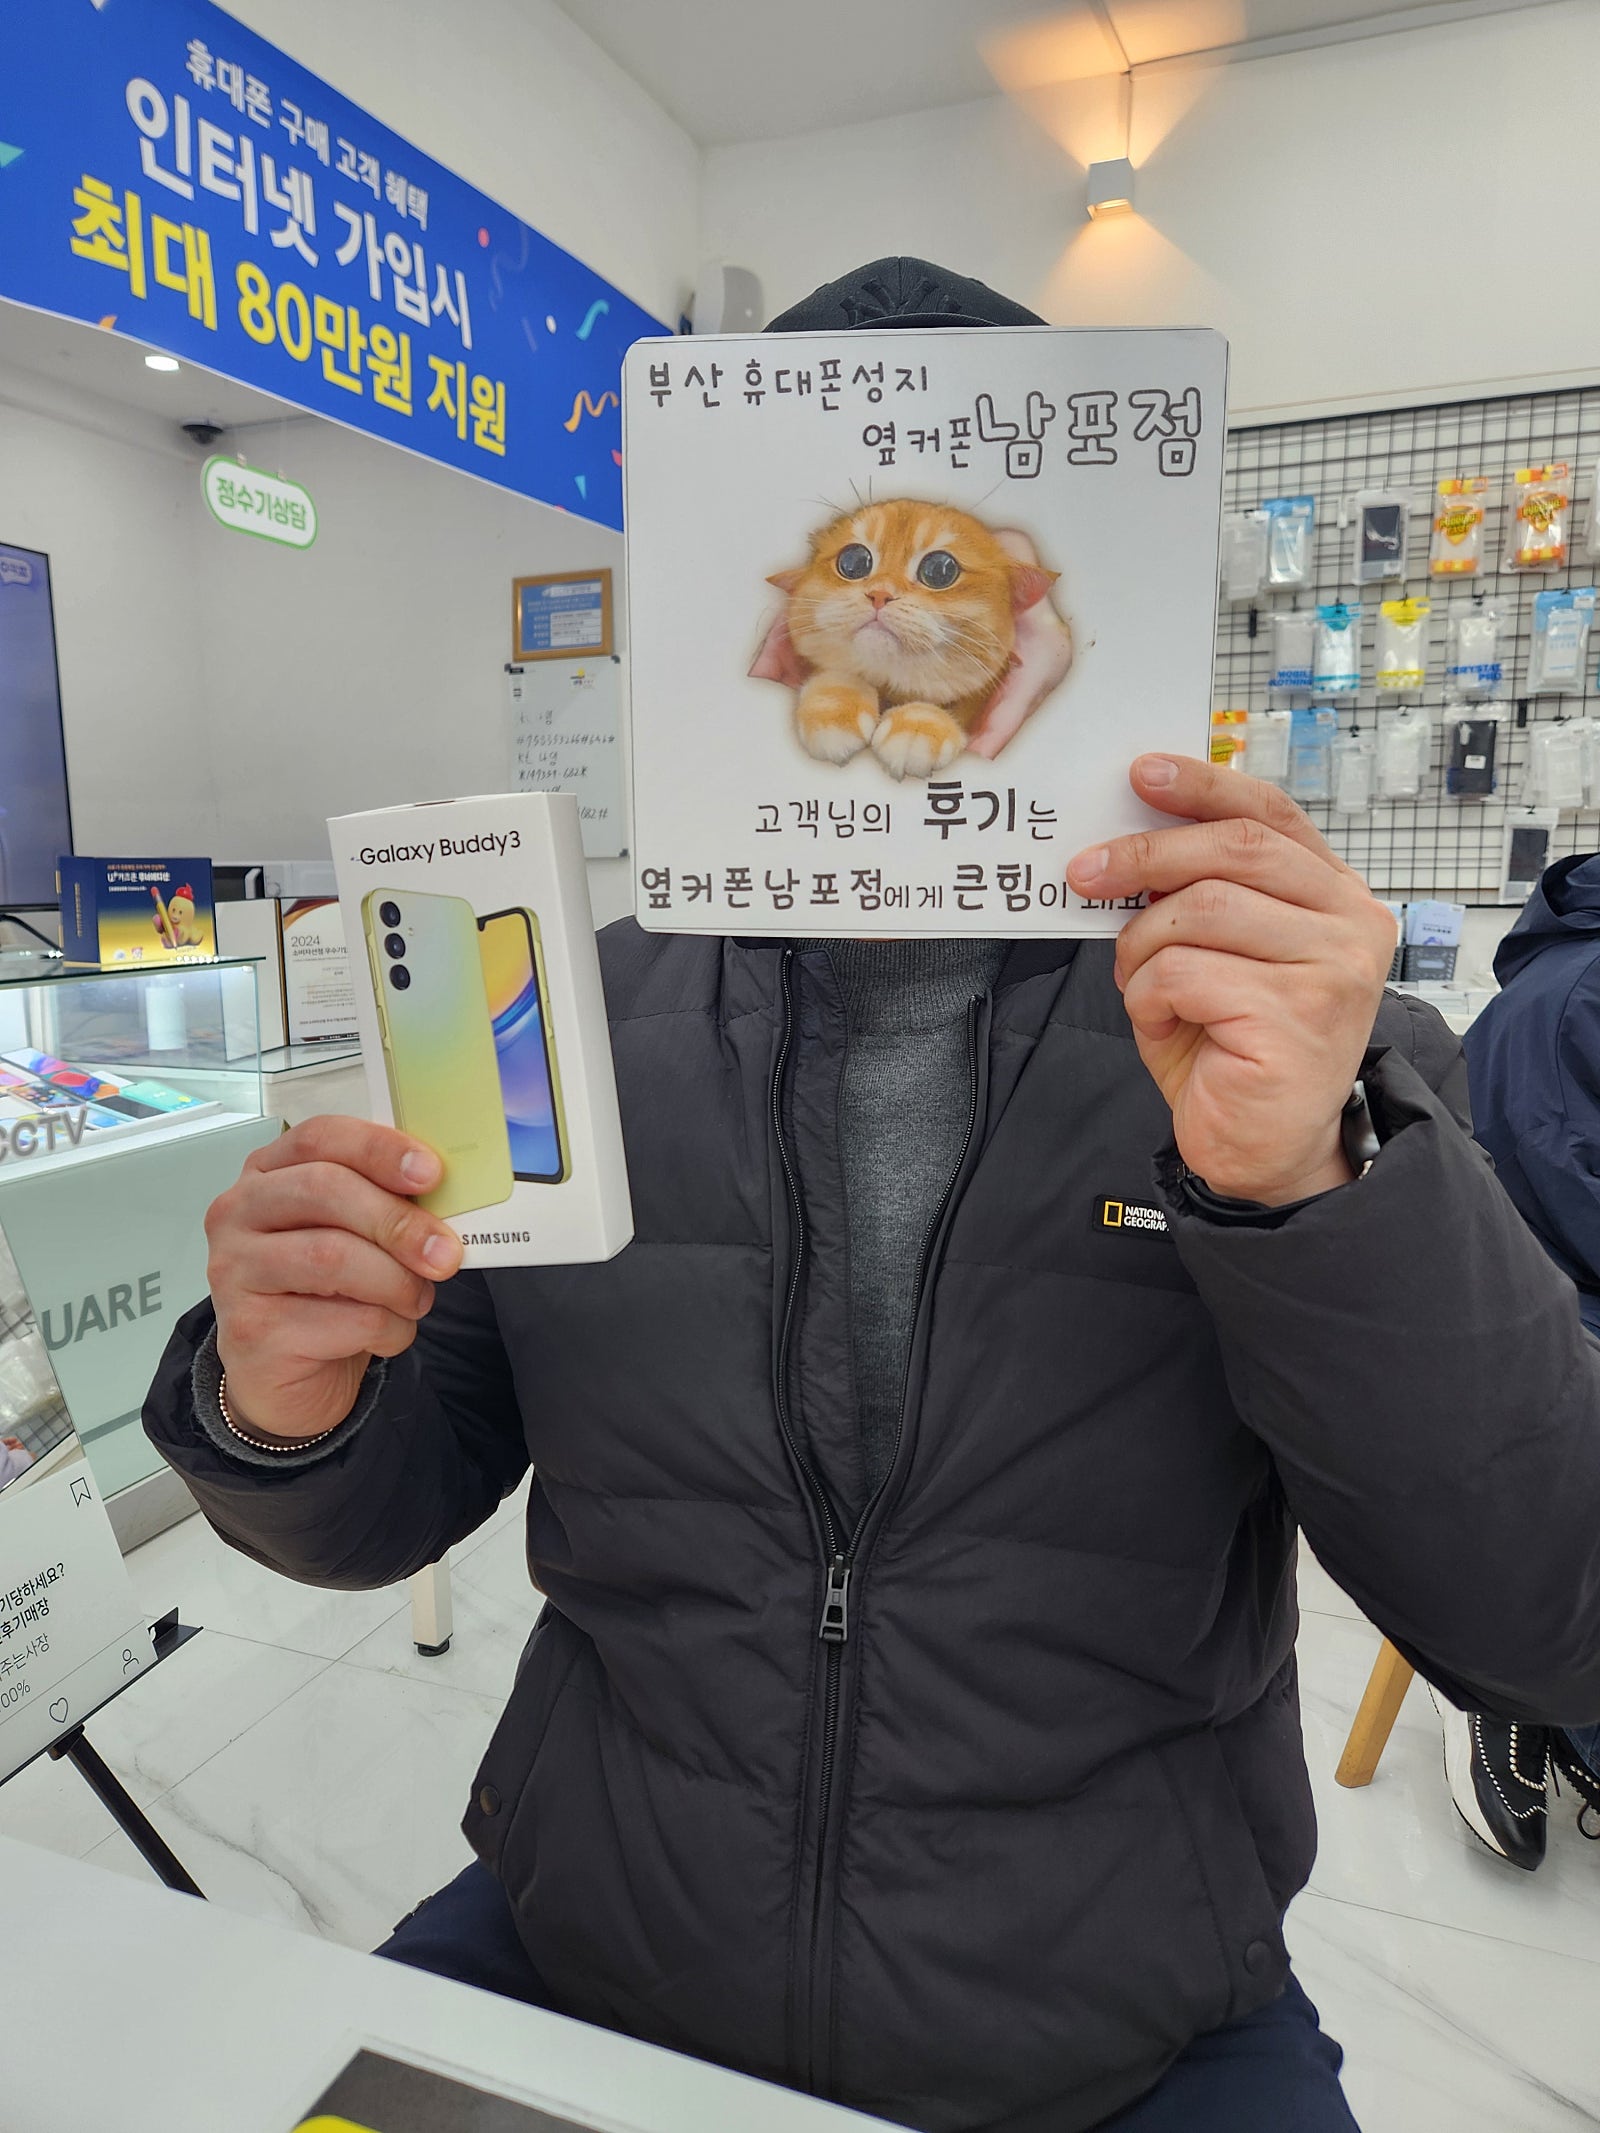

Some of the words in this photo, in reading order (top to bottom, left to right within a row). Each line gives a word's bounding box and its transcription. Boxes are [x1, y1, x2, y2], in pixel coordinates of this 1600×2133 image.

[185, 38, 273, 129] 휴대폰
[279, 98, 331, 168] 구매
[335, 136, 381, 201] 고객
[384, 169, 429, 232] 혜택
[125, 77, 318, 268] 인터넷
[333, 200, 472, 349] 가입시
[70, 173, 218, 330] 최대
[234, 260, 413, 416] 80만원
[427, 355, 506, 456] 지원
[650, 361, 723, 408] 부산
[745, 358, 928, 411] 휴대폰성지
[216, 477, 306, 531] 정수기상담
[755, 799, 891, 840] 고객님의
[924, 780, 1058, 840] 후기는
[360, 843, 434, 865] Galaxy
[439, 830, 521, 857] Buddy3
[291, 935, 320, 947] 2024
[0, 1103, 87, 1161] CTV
[462, 1231, 530, 1246] SAMSUNG
[0, 1597, 50, 1645] 후기매장
